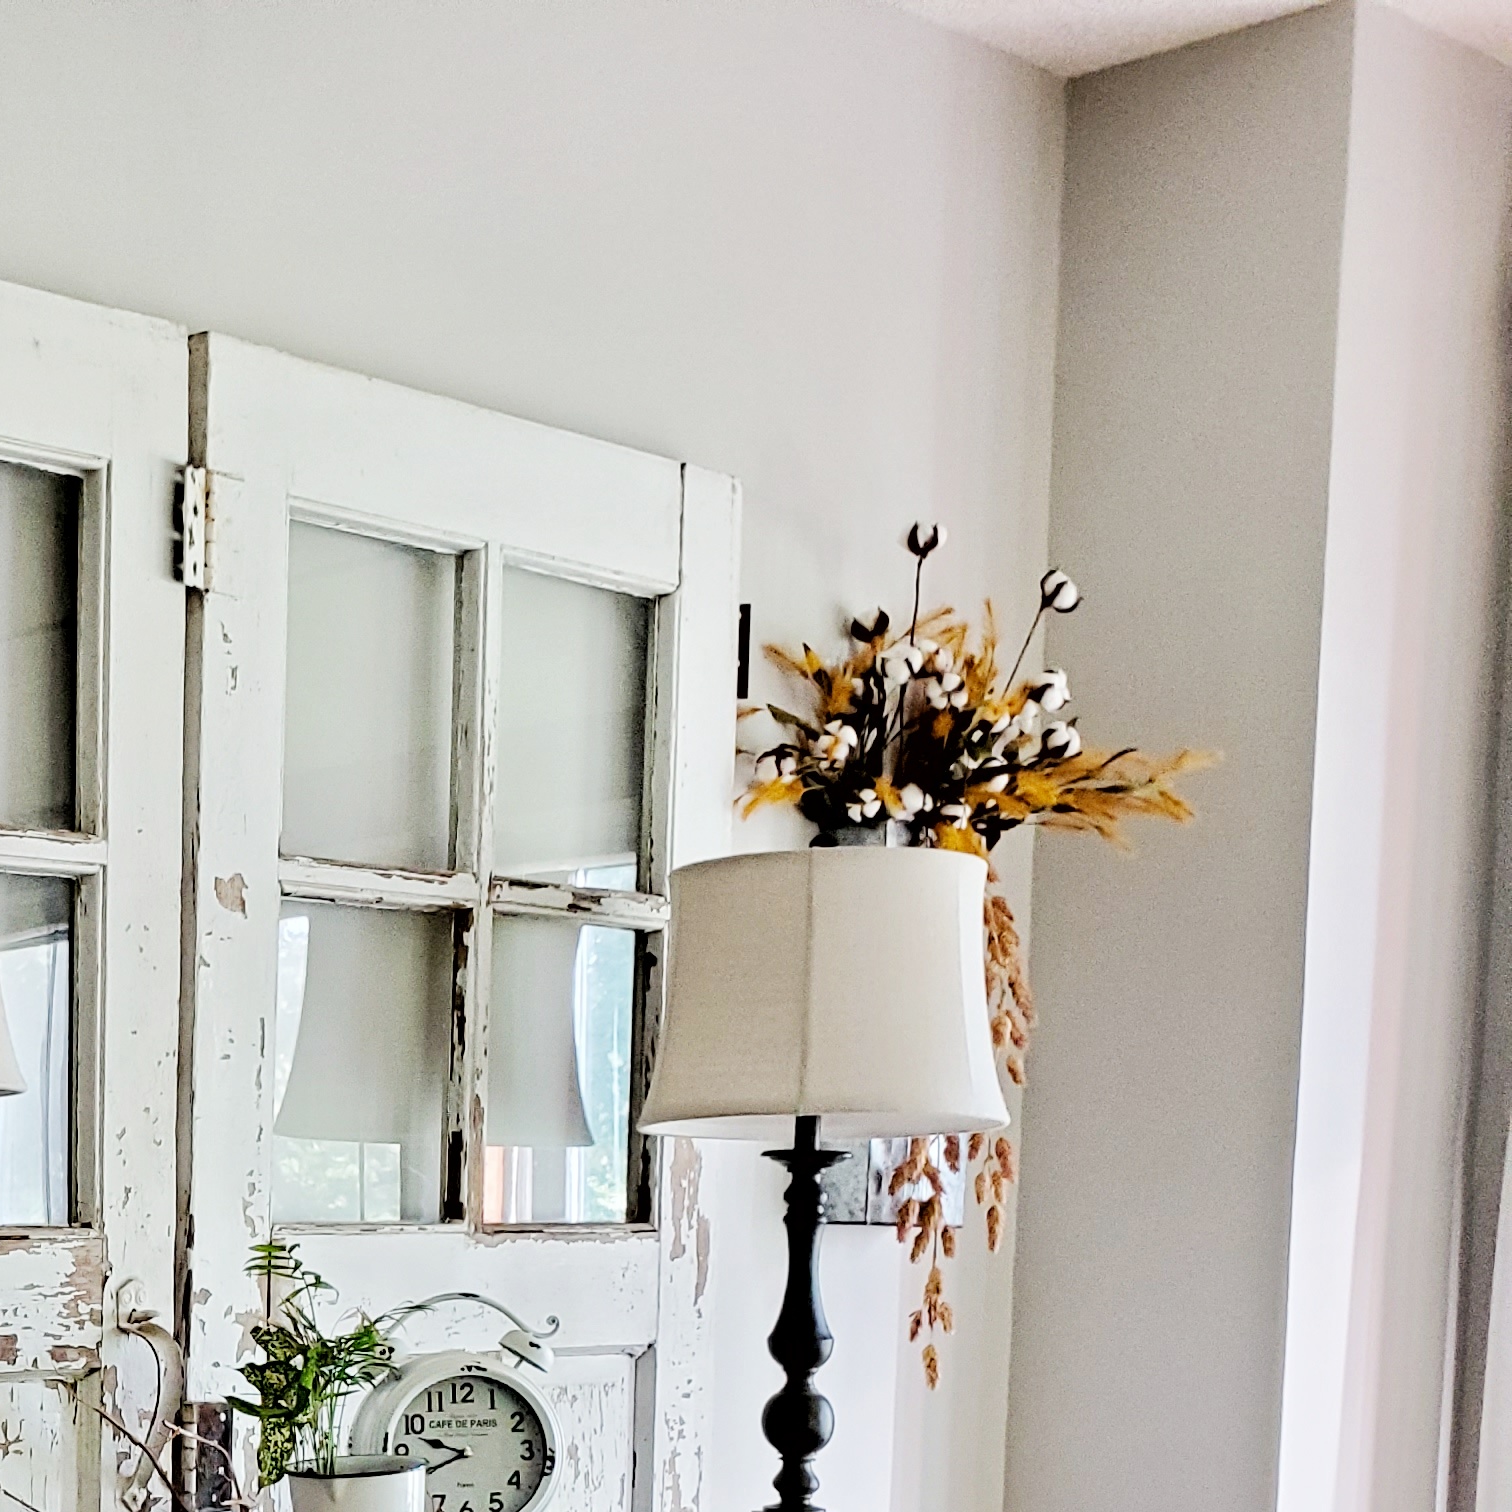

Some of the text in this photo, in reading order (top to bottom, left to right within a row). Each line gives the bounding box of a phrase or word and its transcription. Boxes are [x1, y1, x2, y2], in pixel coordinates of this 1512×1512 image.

[427, 1390, 443, 1412] 11
[450, 1382, 475, 1404] 12
[489, 1388, 497, 1410] 1
[404, 1413, 425, 1435] 10
[429, 1418, 498, 1429] CAFE DE PARIS
[510, 1411, 525, 1433] 2
[520, 1440, 535, 1461] 3
[507, 1470, 521, 1490] 4
[488, 1492, 504, 1512] 5
